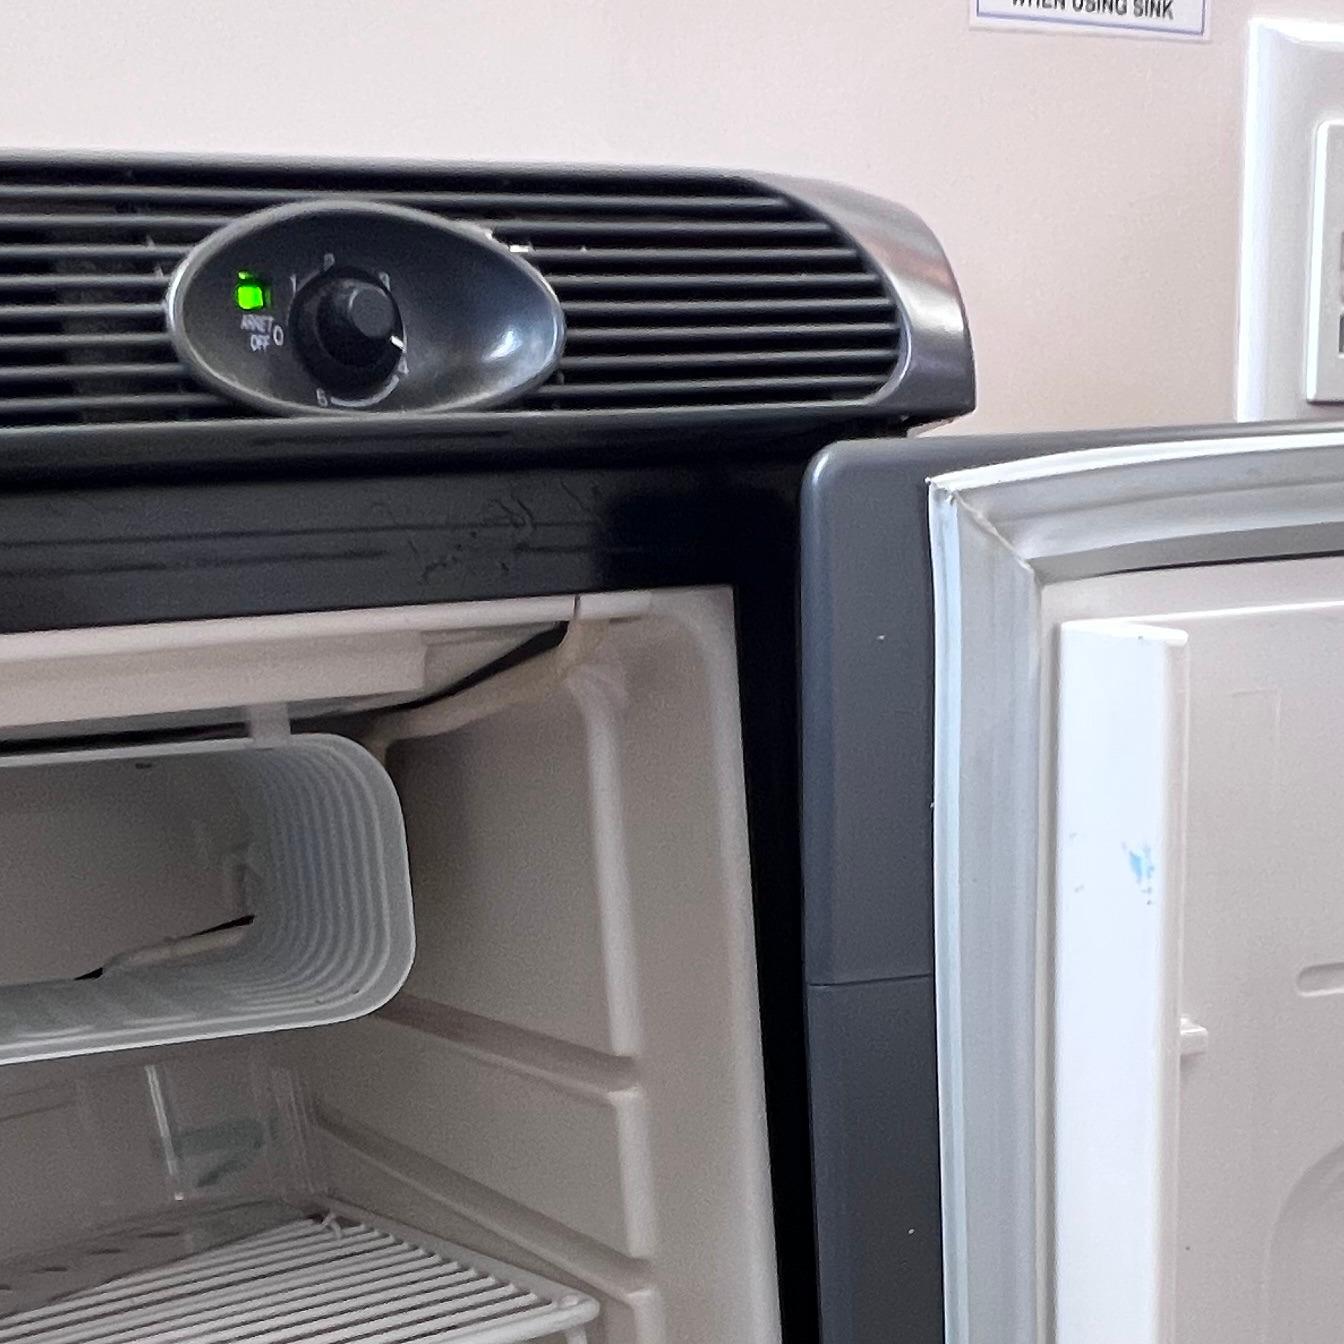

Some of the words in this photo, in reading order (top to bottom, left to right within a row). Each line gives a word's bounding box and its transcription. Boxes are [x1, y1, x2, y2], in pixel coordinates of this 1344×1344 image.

[1073, 0, 1127, 15] USING
[1134, 0, 1174, 20] SINK
[250, 334, 270, 351] OFF
